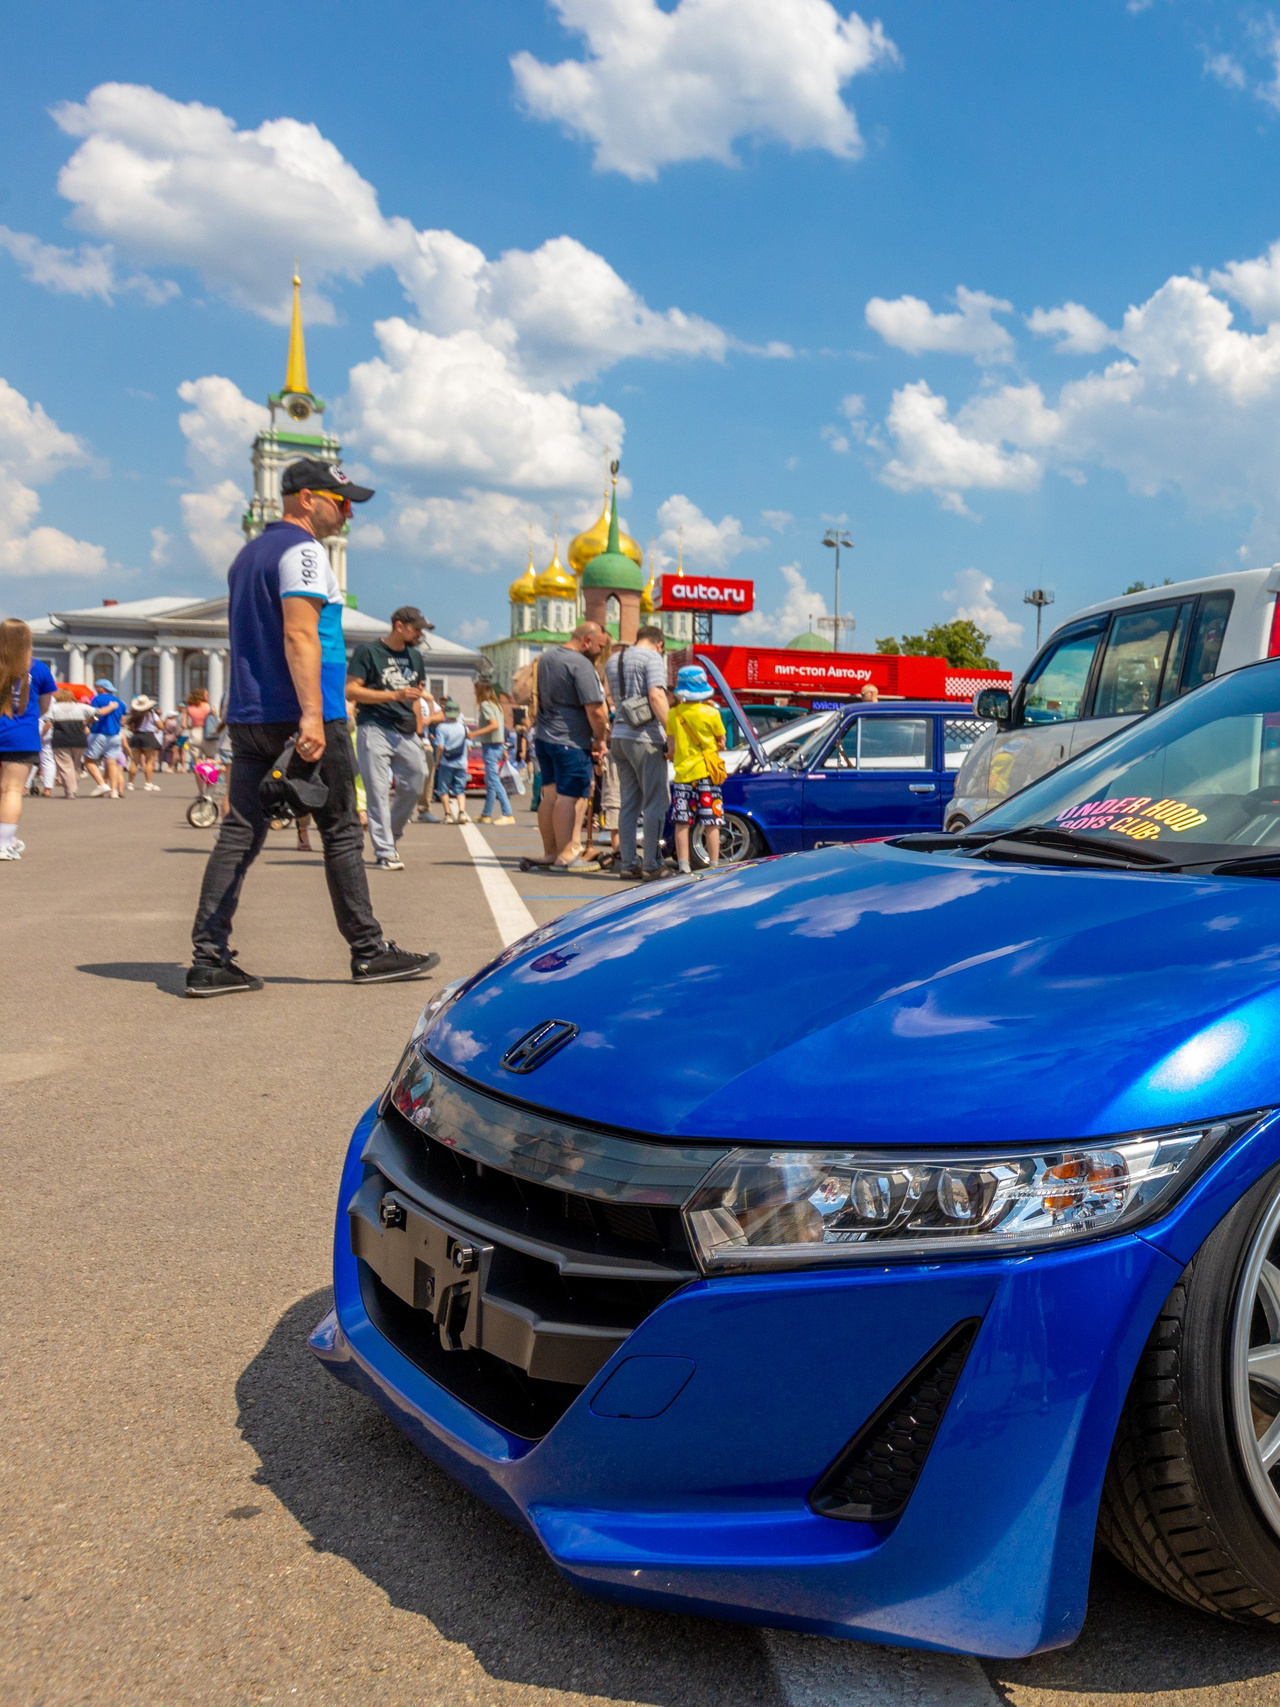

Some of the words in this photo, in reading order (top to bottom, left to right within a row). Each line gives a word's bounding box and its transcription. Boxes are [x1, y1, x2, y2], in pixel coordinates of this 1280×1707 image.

[301, 549, 318, 586] 1890
[672, 584, 745, 602] auto.ru
[774, 665, 826, 676] пит-стоп
[827, 666, 872, 681] Авто.ру
[1056, 797, 1152, 822] UNDER
[1139, 799, 1208, 832] HOOD
[1108, 816, 1161, 840] CLUB.
